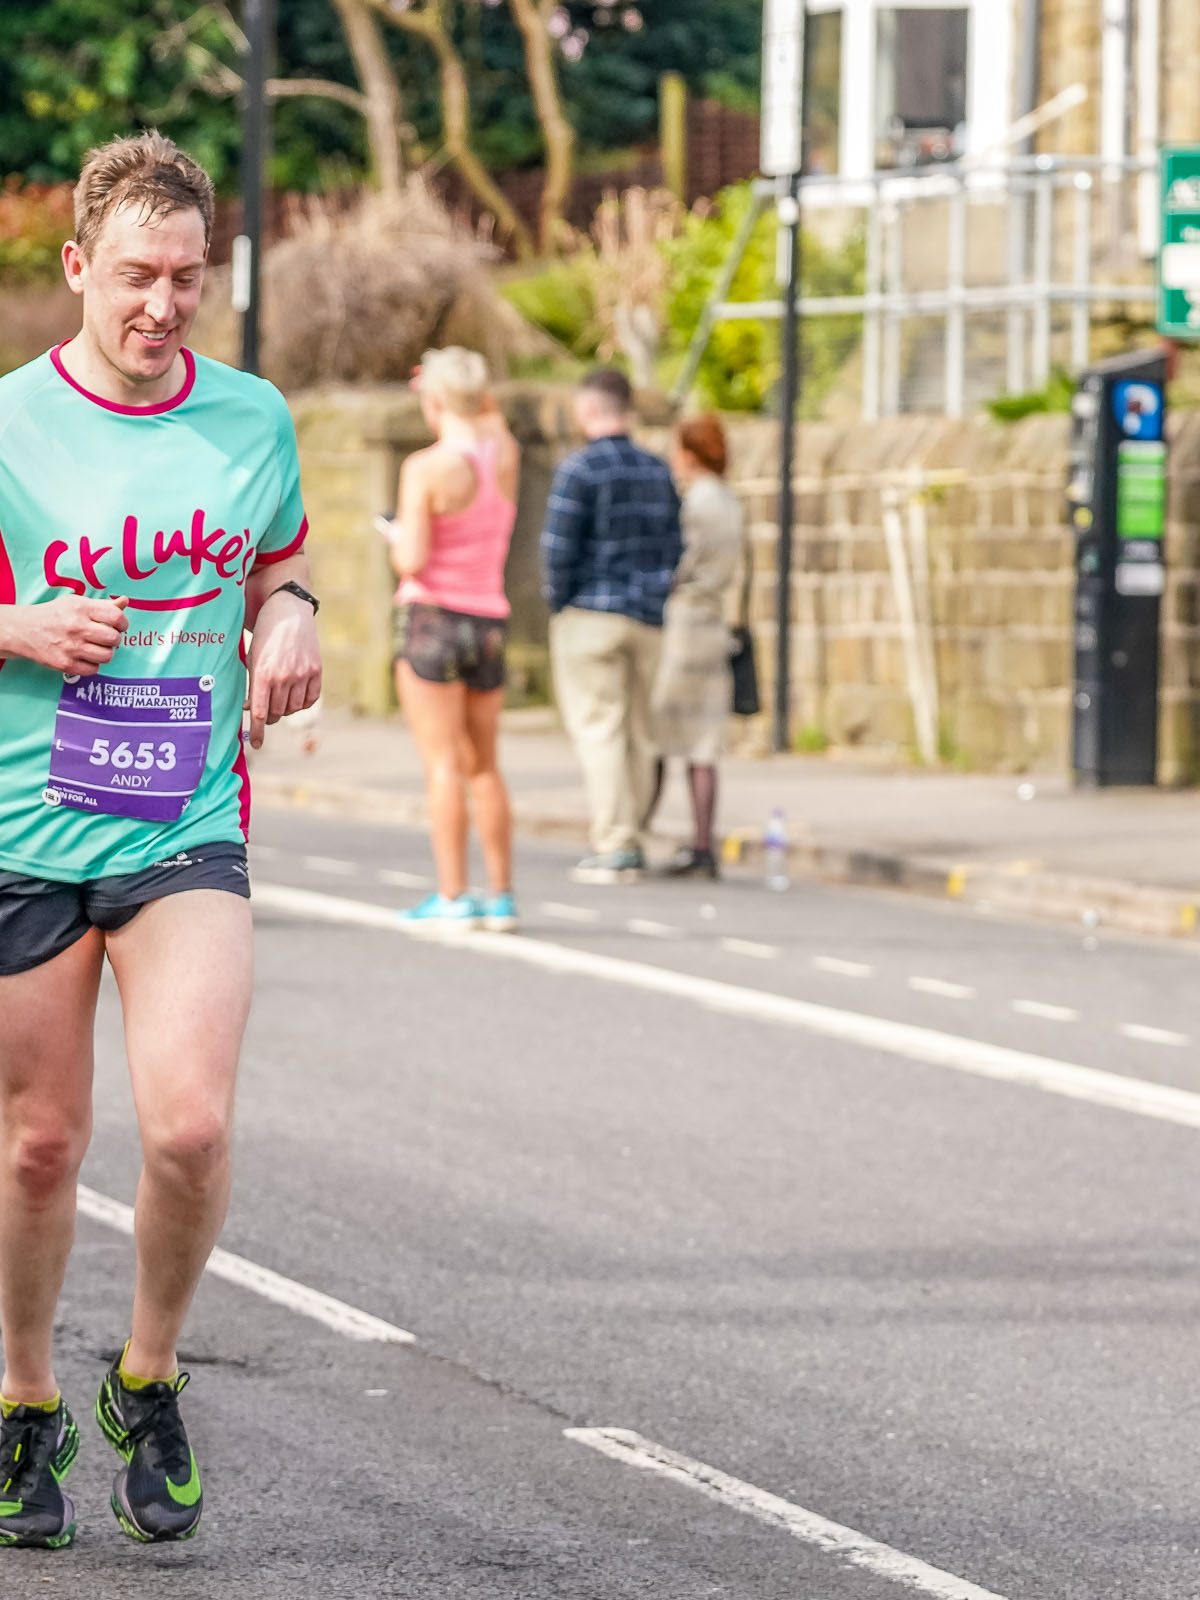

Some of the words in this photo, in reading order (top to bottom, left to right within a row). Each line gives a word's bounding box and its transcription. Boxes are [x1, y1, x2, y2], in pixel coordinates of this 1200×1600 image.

[171, 628, 225, 647] Hospice
[105, 685, 158, 695] SHEFFIELD
[105, 694, 134, 707] HALF
[135, 696, 197, 707] MARATHON
[169, 708, 197, 720] 2022
[89, 738, 177, 771] 5653
[111, 773, 152, 788] ANDY
[68, 793, 83, 802] FOR
[84, 797, 98, 806] ALL
